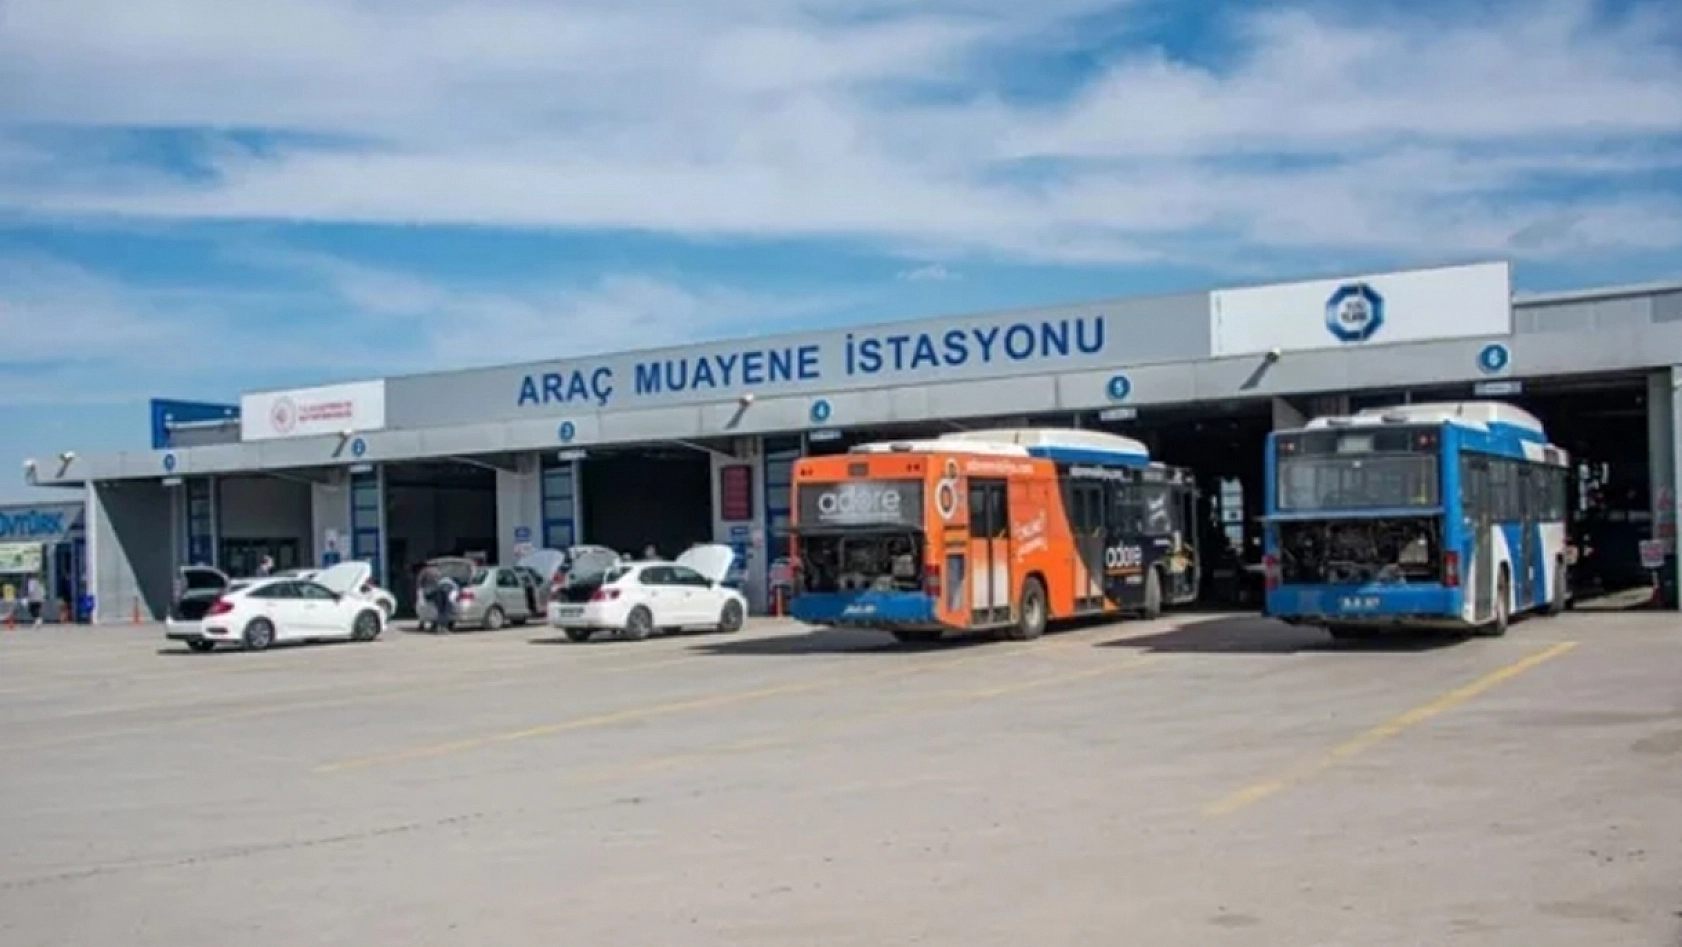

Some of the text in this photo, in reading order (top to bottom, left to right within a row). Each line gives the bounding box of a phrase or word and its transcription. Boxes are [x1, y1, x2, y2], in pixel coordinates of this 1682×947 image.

[517, 316, 1104, 407] ARAÇ MUAYENE İSTASYONU
[818, 485, 900, 514] adore
